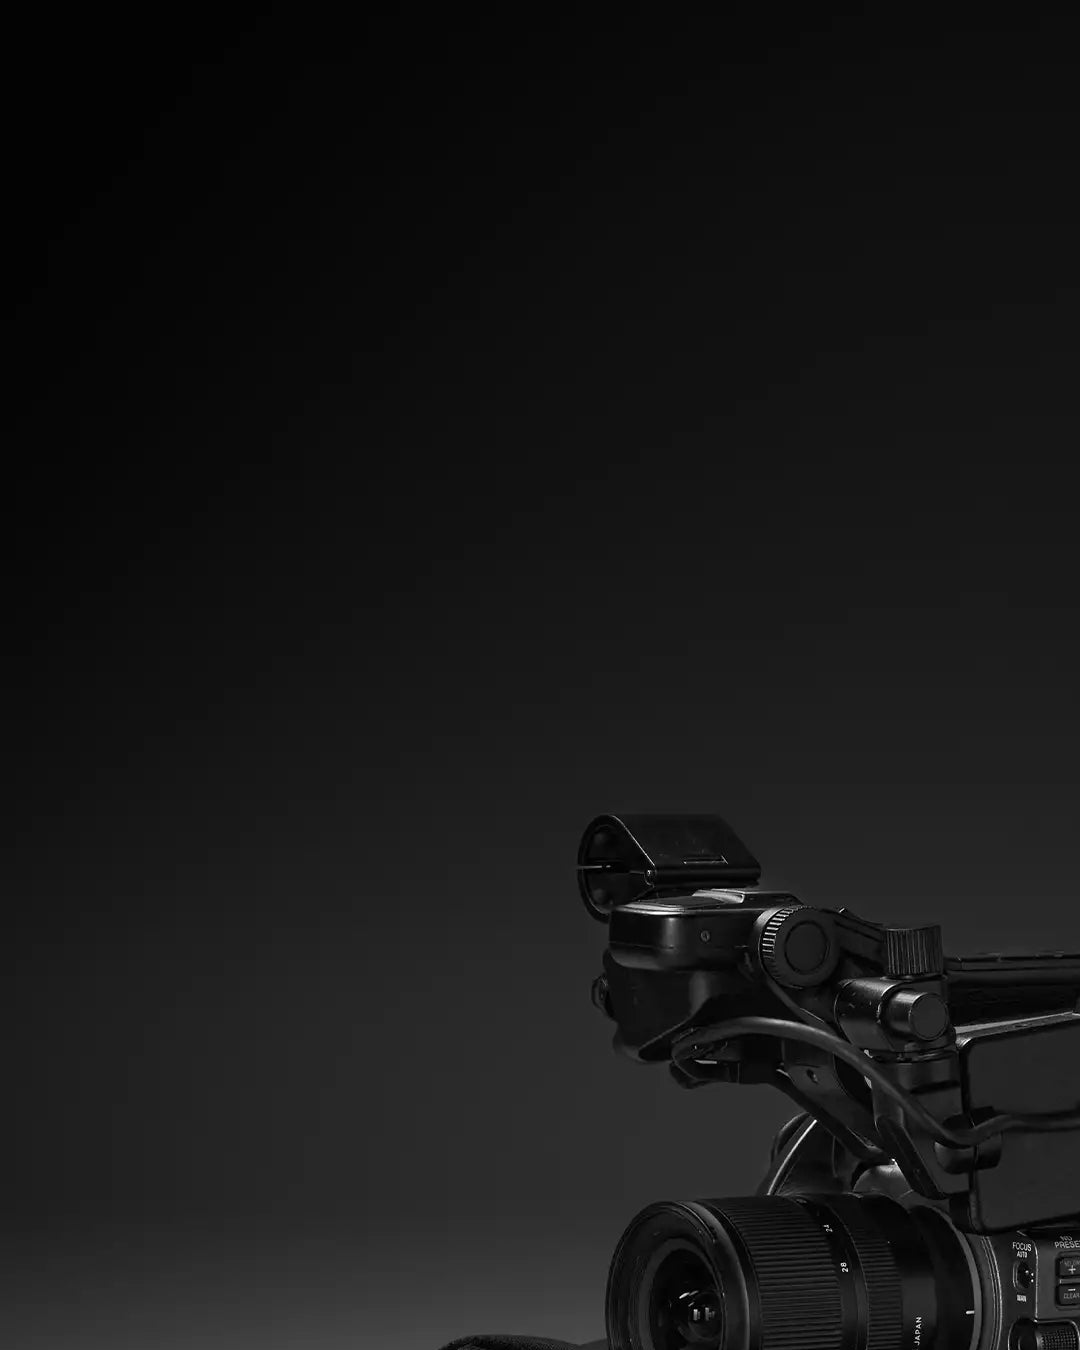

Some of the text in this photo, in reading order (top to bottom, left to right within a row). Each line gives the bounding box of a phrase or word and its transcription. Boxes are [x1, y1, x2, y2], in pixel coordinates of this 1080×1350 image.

[1012, 1242, 1031, 1251] FOCUS
[840, 1262, 849, 1273] 28
[914, 1316, 922, 1346] JAPAN
